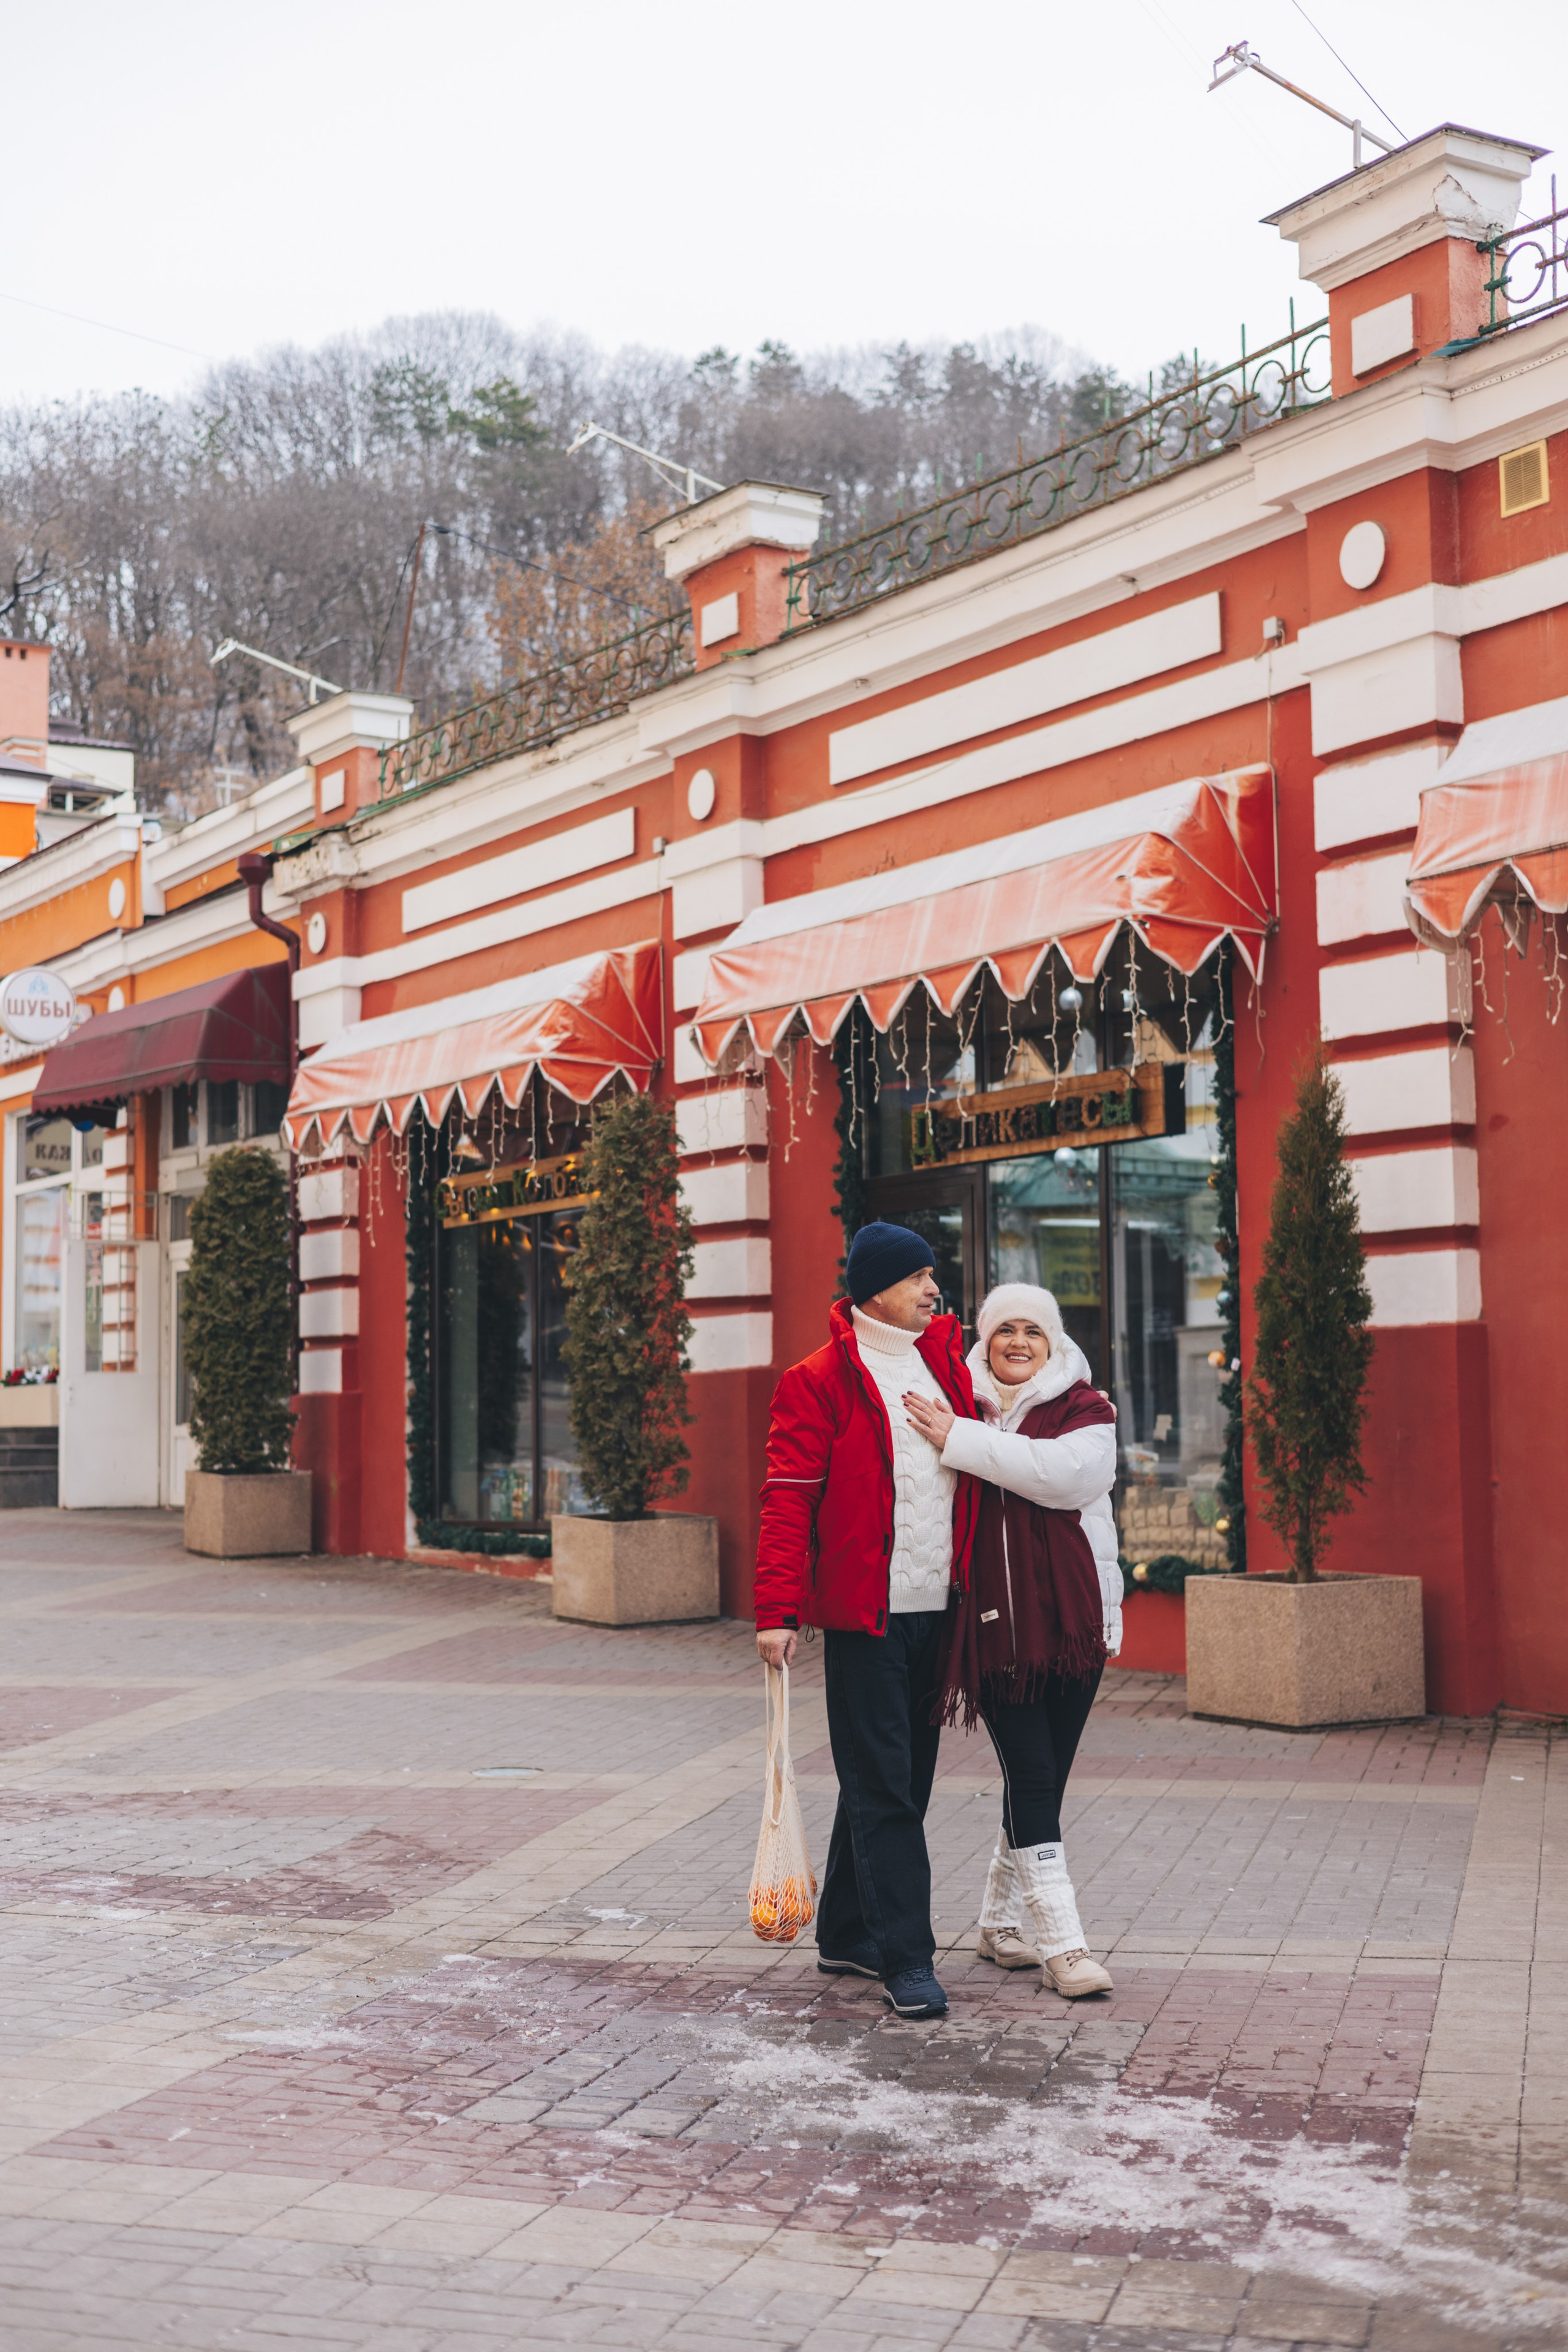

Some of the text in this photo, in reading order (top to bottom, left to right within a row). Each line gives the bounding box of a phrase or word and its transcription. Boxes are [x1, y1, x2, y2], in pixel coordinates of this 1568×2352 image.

[7, 998, 70, 1018] ШУБЫ
[910, 1087, 1134, 1167] Деликатесы
[513, 1164, 582, 1205] Колба
